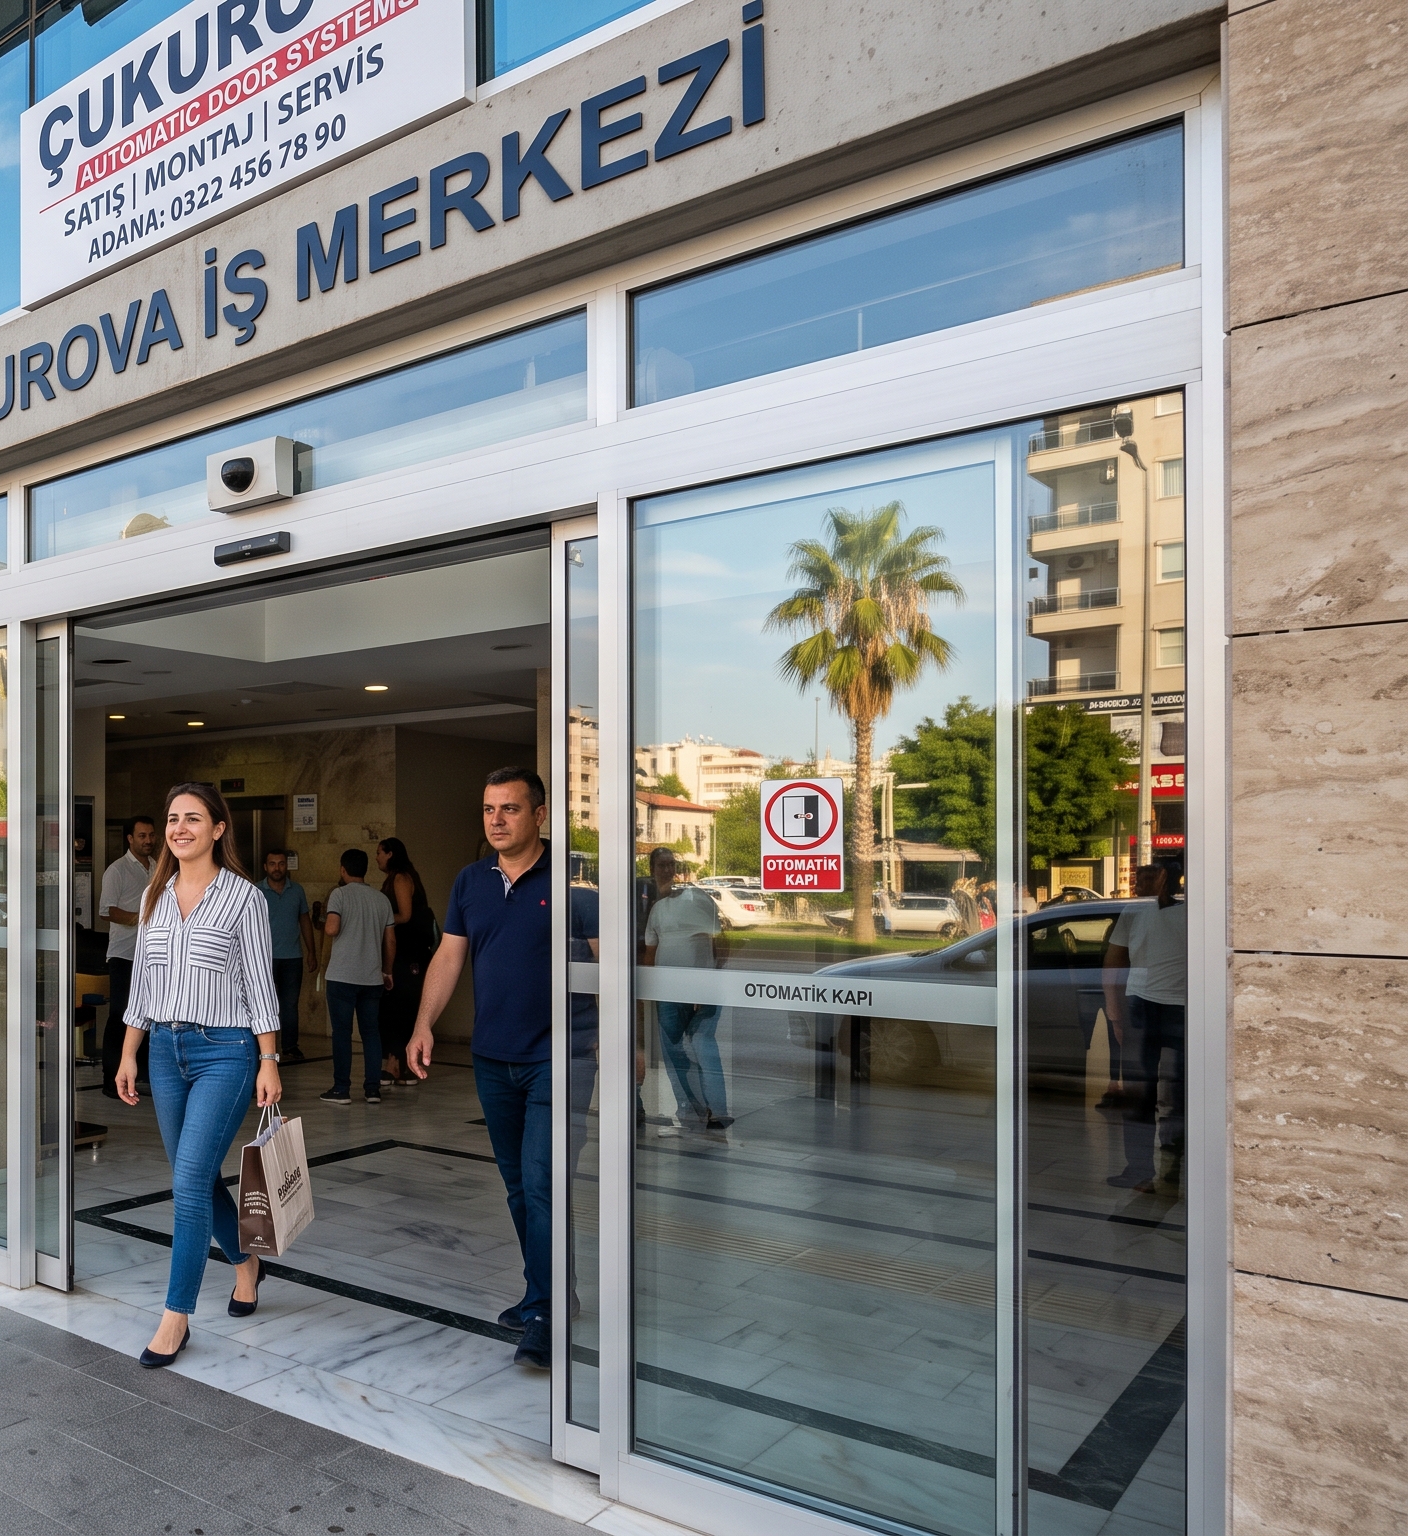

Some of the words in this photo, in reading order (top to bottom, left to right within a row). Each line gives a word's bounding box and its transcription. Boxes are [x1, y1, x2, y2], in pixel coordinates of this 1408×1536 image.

[64, 182, 126, 237] SATIŞ
[144, 112, 253, 196] MONTAJ
[278, 43, 384, 125] SERVİS
[79, 101, 200, 189] AUTOMATIC
[208, 57, 278, 117] DOOR
[88, 207, 165, 263] ADANA:
[170, 175, 223, 221] 0322
[229, 149, 272, 191] 456
[278, 132, 308, 169] 78
[315, 113, 347, 152] 90
[204, 247, 269, 346] İŞ
[296, 0, 766, 302] MERKEZİ
[766, 857, 838, 871] OTOMATİK
[785, 873, 818, 886] KAPI
[744, 983, 827, 1003] OTOMATİK
[832, 989, 873, 1006] KAPI
